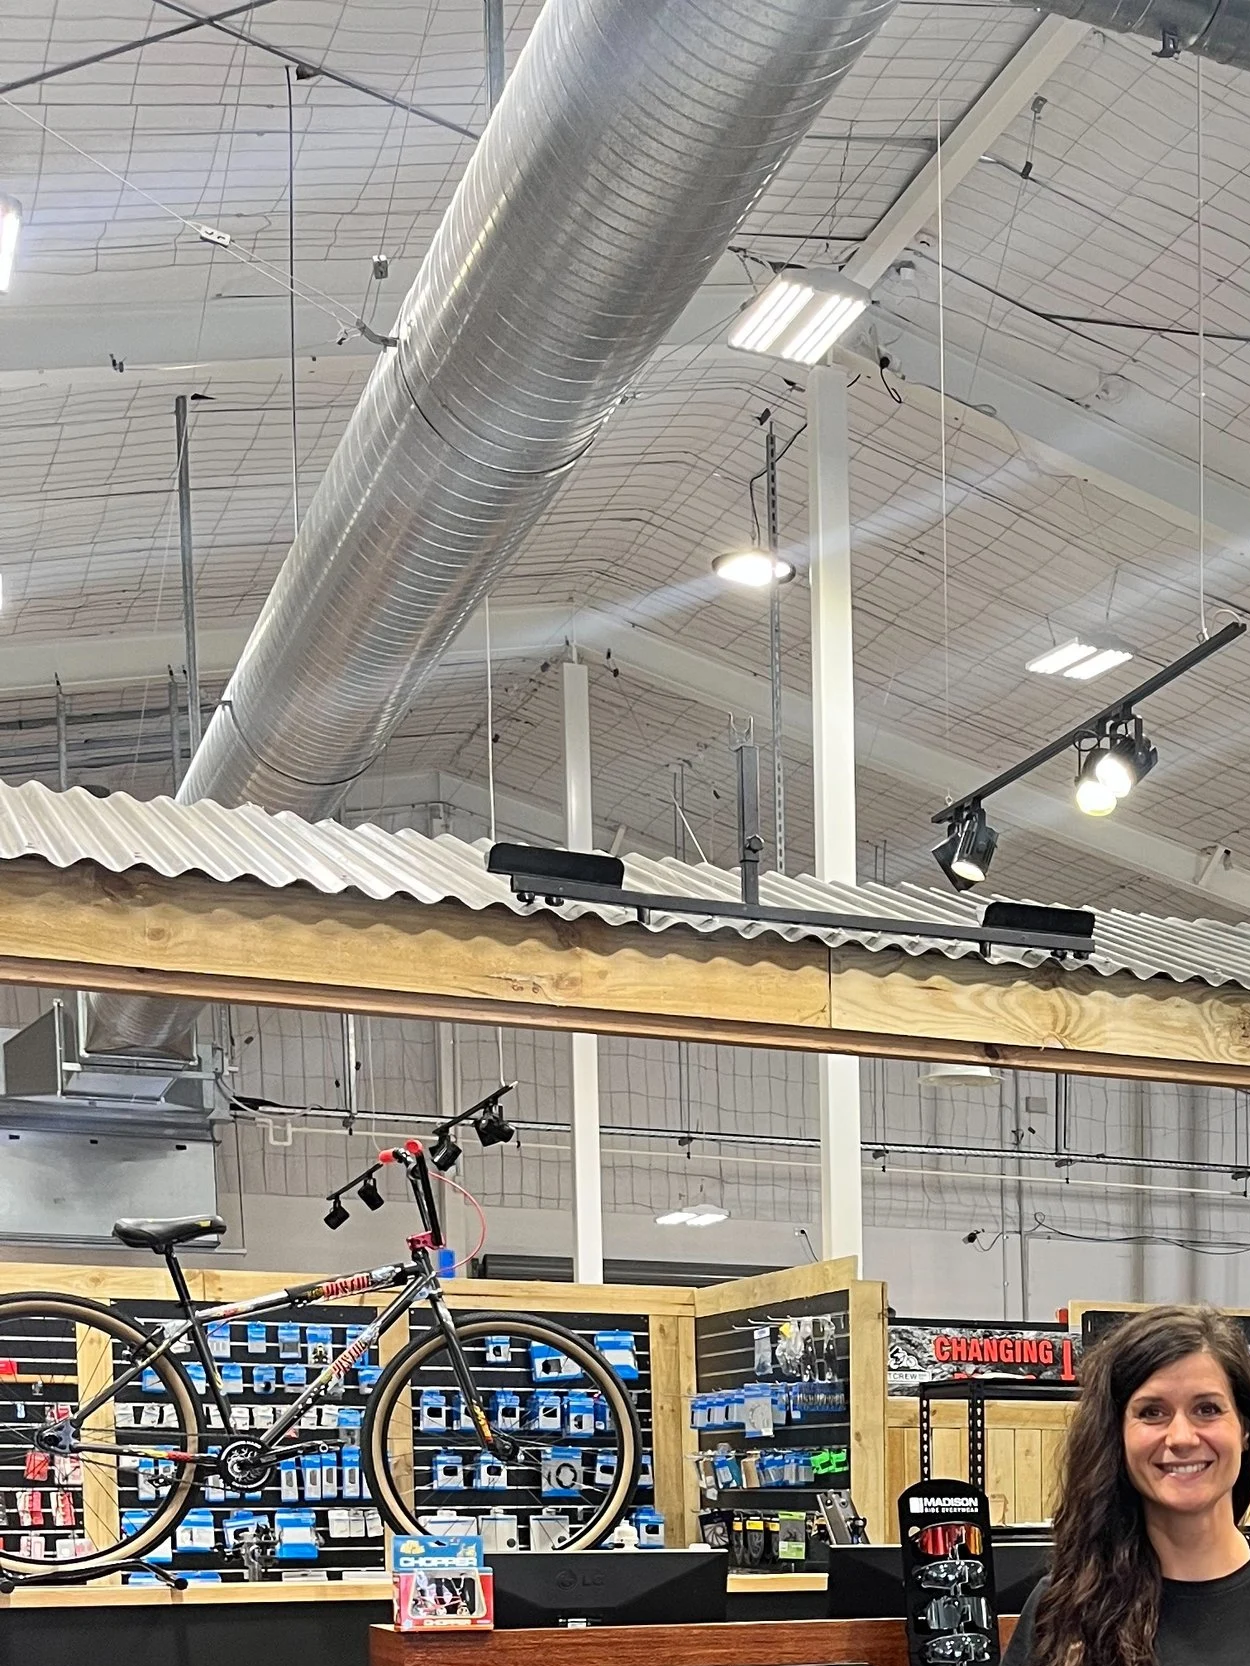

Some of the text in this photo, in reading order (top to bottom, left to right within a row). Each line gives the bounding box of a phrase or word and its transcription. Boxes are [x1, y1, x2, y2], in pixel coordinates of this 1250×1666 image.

[933, 1335, 1054, 1365] CHANGING
[923, 1497, 979, 1507] MADISON
[399, 1556, 477, 1567] CHOPPER
[582, 1575, 605, 1587] LG
